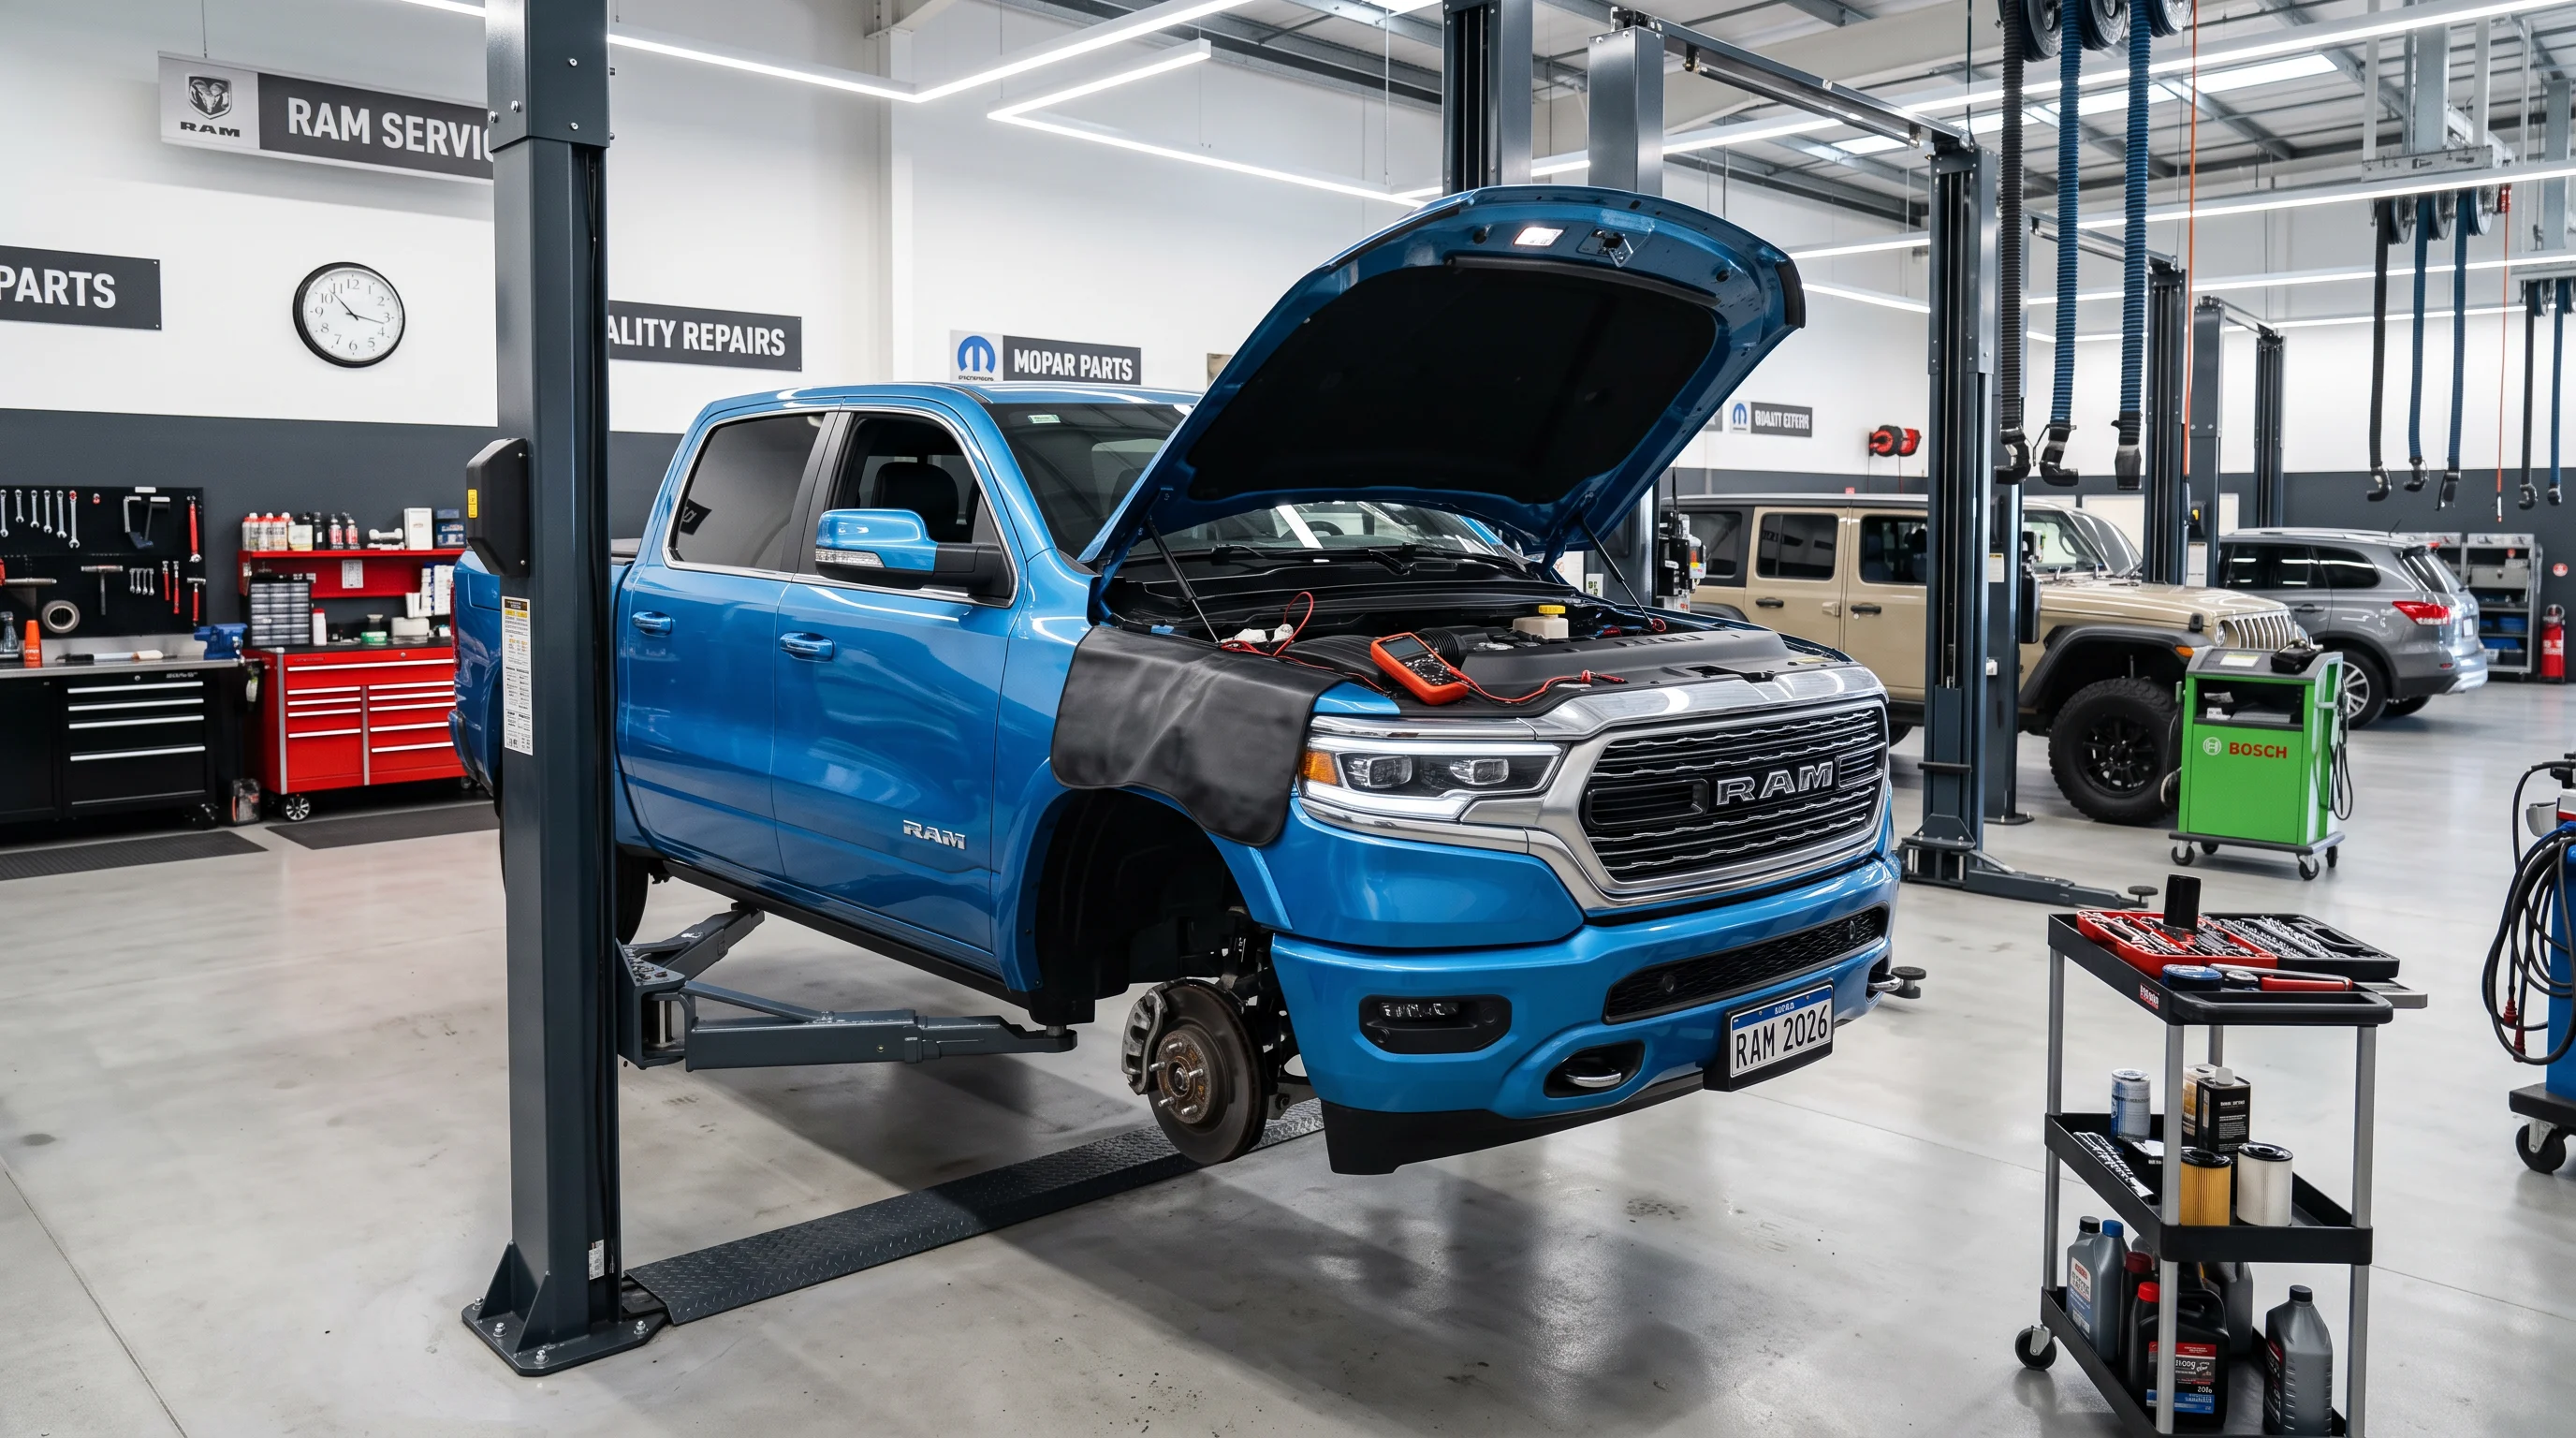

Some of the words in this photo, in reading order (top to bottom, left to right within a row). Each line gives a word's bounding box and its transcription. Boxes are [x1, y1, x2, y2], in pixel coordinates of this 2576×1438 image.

[287, 96, 371, 145] RAM
[180, 121, 241, 138] RAM
[0, 264, 117, 309] PARTS
[332, 283, 343, 295] 11
[347, 279, 359, 290] 12
[321, 293, 334, 304] 10
[376, 296, 385, 307] 2
[315, 306, 324, 317] 9
[383, 312, 391, 323] 3
[320, 322, 329, 333] 8
[376, 326, 385, 337] 4
[334, 333, 343, 345] 7
[368, 337, 375, 347] 5
[682, 321, 785, 357] REPAIRS
[349, 340, 358, 351] 6
[1014, 348, 1076, 376] MOPAR
[1080, 354, 1133, 382] PARTS
[2229, 741, 2288, 759] BOSCH
[1716, 760, 1834, 806] RAM
[903, 819, 966, 850] RAM
[1735, 1022, 1776, 1069] RAM
[1782, 1004, 1828, 1052] 2026
